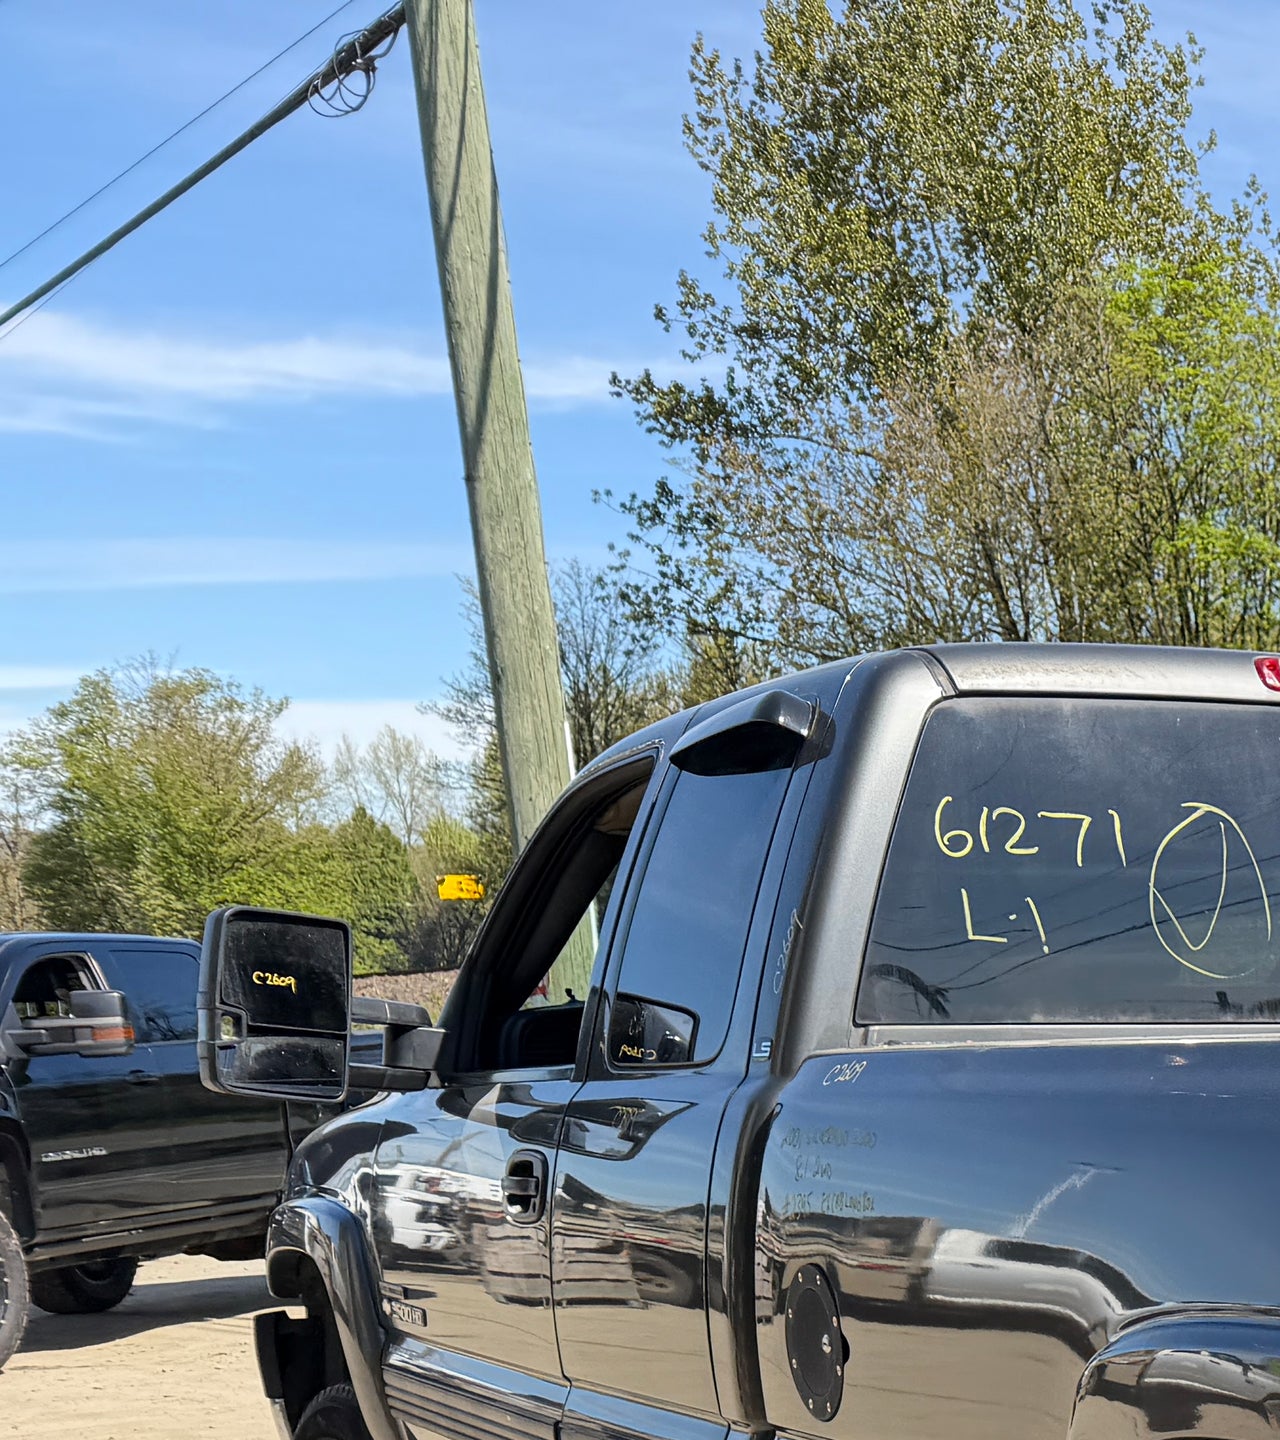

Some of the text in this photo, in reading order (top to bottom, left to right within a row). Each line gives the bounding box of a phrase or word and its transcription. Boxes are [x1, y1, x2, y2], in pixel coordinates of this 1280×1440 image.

[934, 795, 1127, 867] 61271
[252, 971, 297, 994] C2609
[752, 1041, 772, 1058] LS
[822, 1059, 867, 1086] C2609
